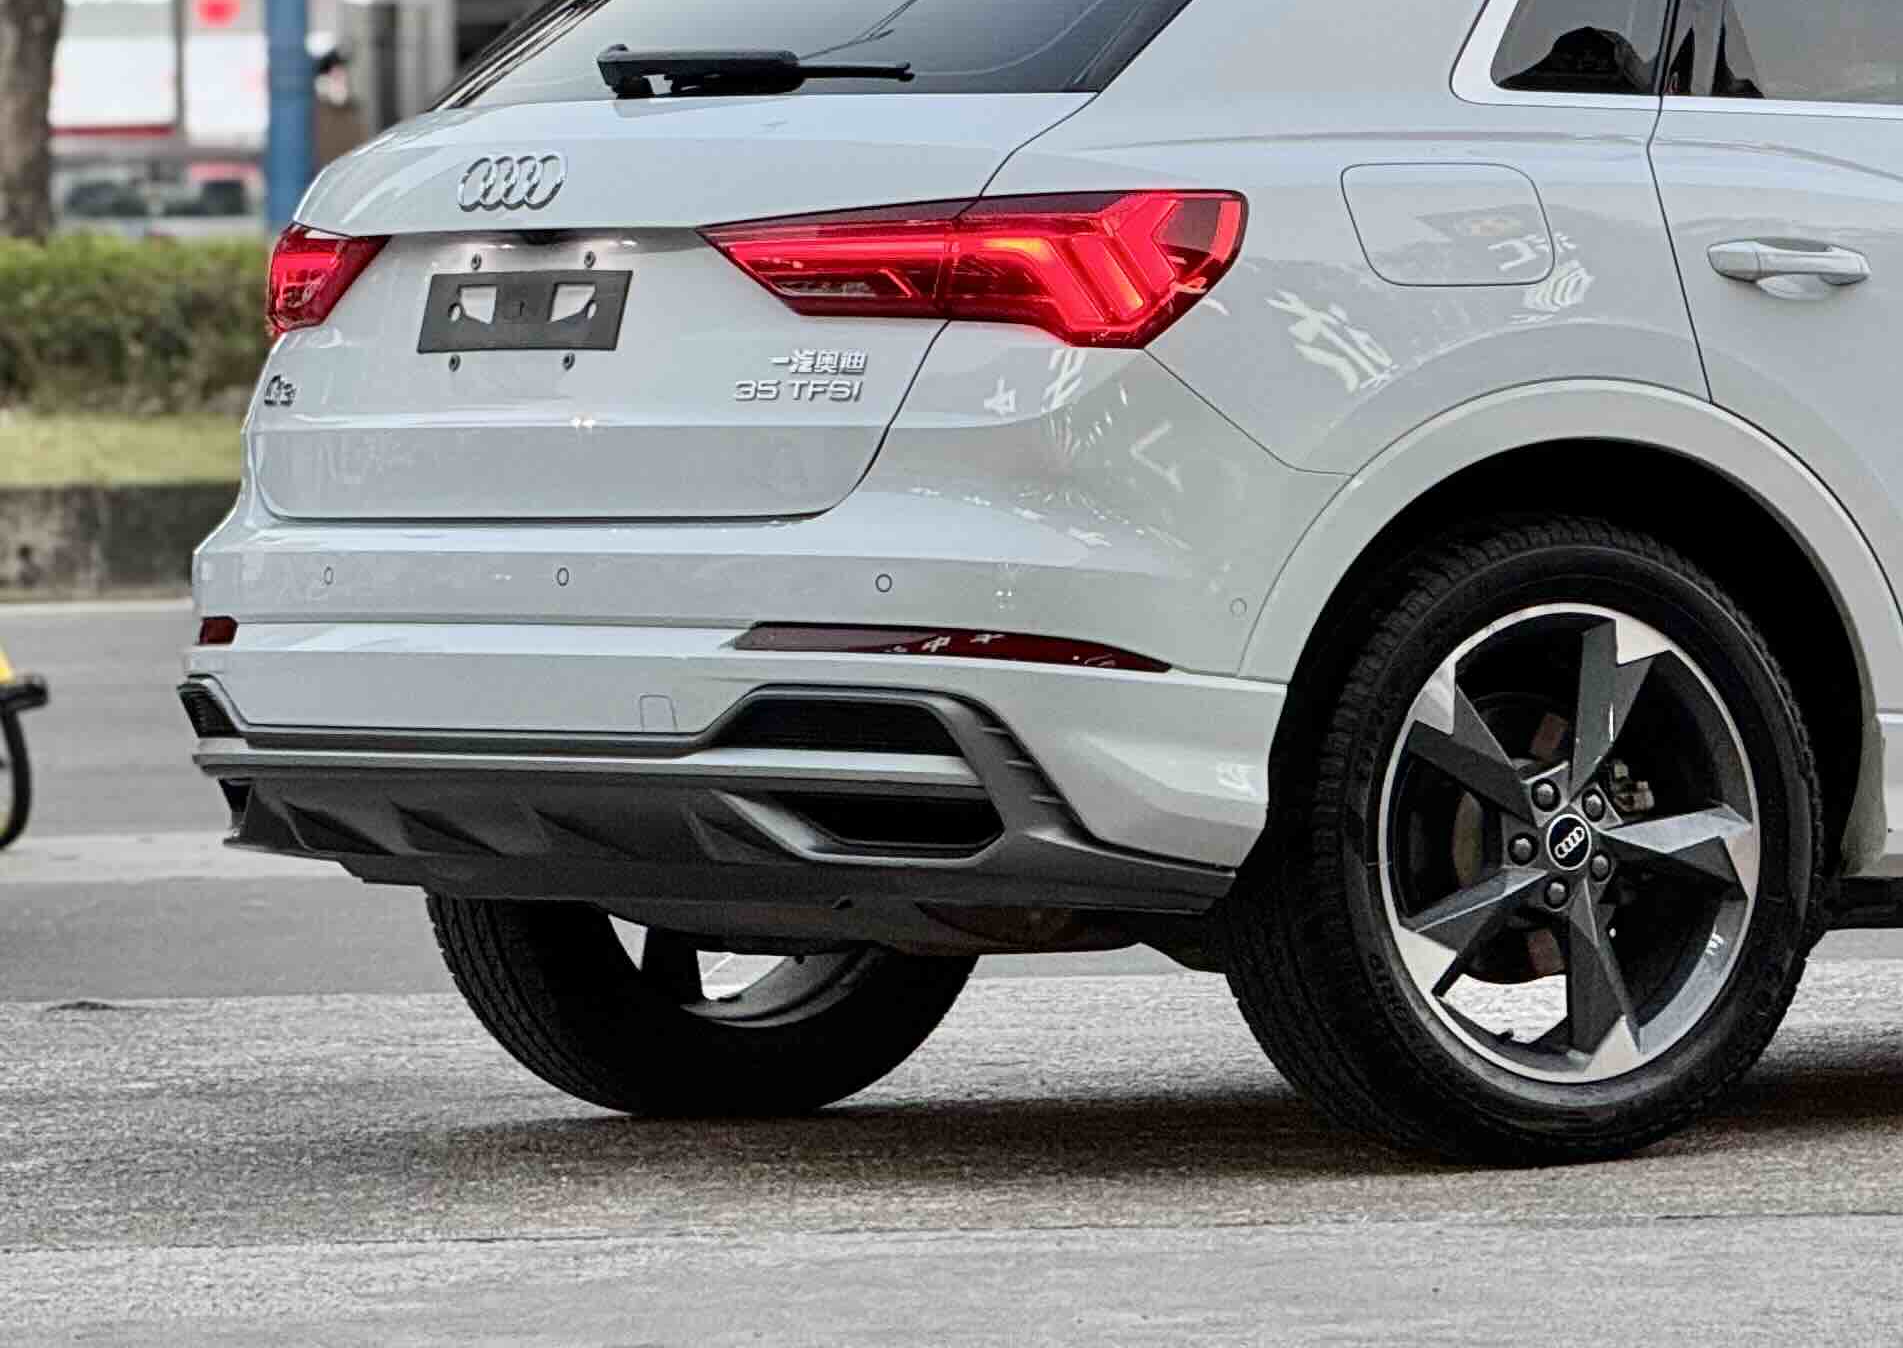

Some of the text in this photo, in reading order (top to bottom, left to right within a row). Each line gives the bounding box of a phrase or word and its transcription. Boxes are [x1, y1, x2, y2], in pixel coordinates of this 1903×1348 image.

[769, 349, 867, 375] 一汽奥迪
[734, 379, 864, 402] 35 TFSI
